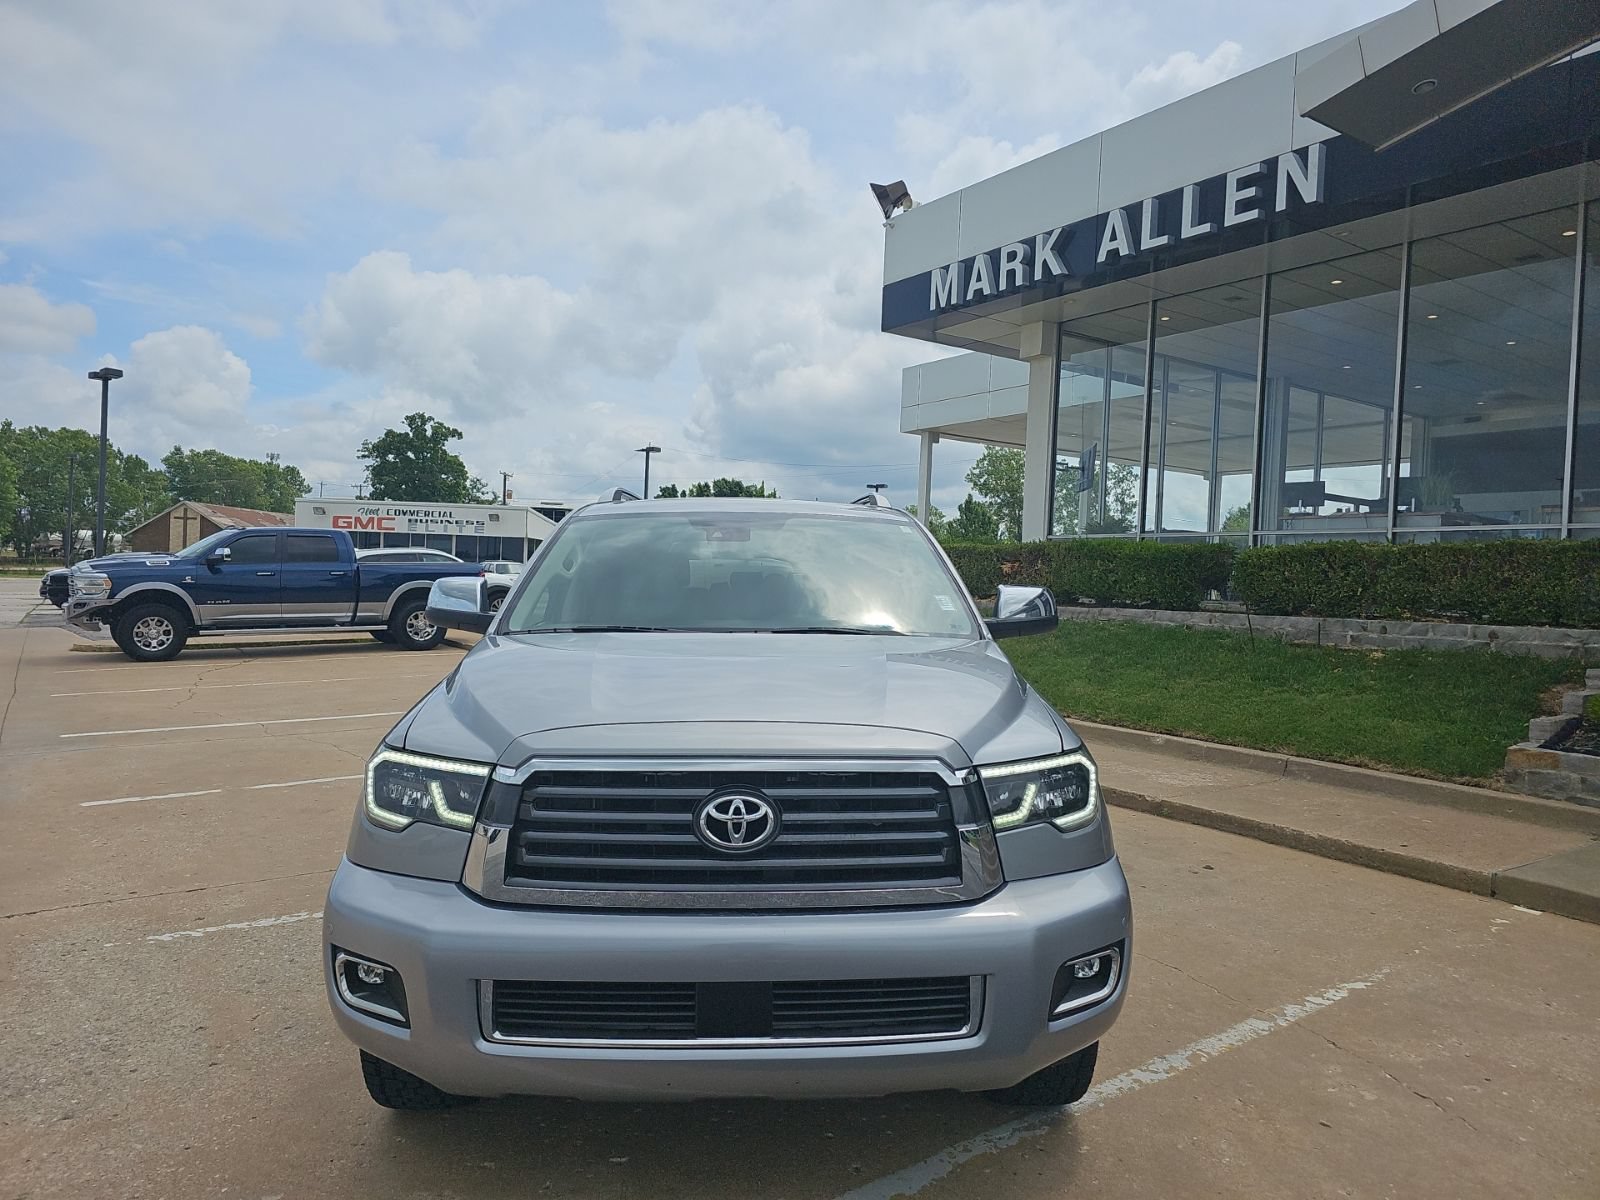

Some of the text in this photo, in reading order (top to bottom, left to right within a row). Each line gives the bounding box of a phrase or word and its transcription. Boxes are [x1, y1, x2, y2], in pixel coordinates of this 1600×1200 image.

[929, 143, 1327, 311] MARK ALLEN
[357, 507, 456, 519] Fleet COMMERCIAL
[332, 515, 396, 531] GMC
[407, 518, 485, 526] BUSINESS
[407, 522, 485, 535] ELITE
